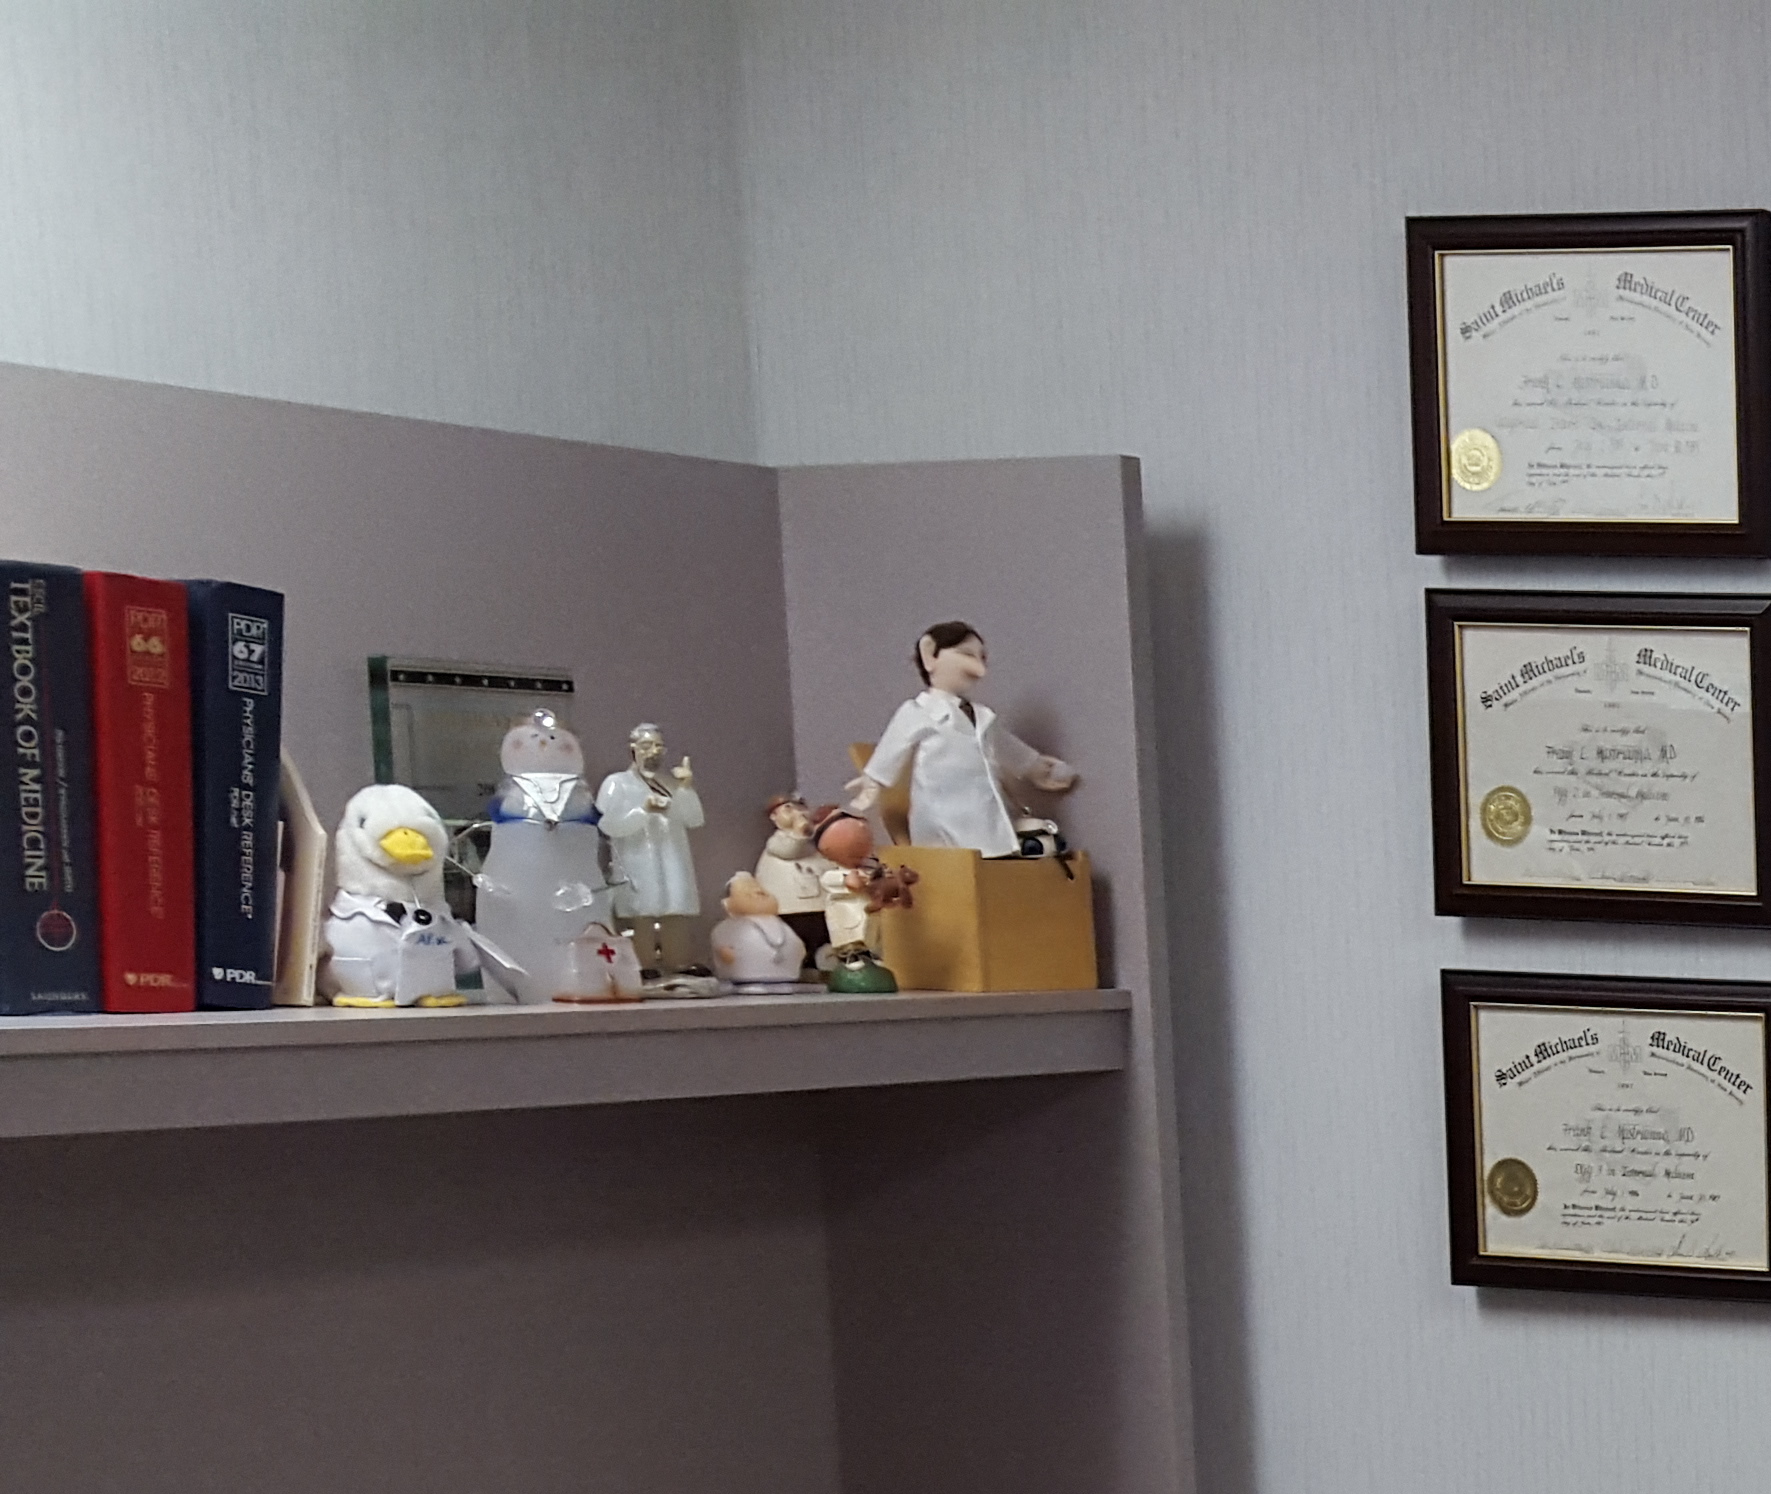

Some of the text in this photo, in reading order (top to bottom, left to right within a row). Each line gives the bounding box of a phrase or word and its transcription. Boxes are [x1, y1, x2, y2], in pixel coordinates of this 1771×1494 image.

[1616, 271, 1673, 306] Medical
[130, 634, 165, 653] 66
[232, 641, 265, 662] 67
[232, 671, 265, 690] 2013
[1479, 646, 1740, 713] Saint Michael's Medical Center
[10, 581, 47, 892] TEXTBOOK OF MEDICINE
[241, 790, 255, 827] DESK
[226, 968, 256, 983] PDR
[1494, 1028, 1753, 1095] Saint Michael's Medical Center
